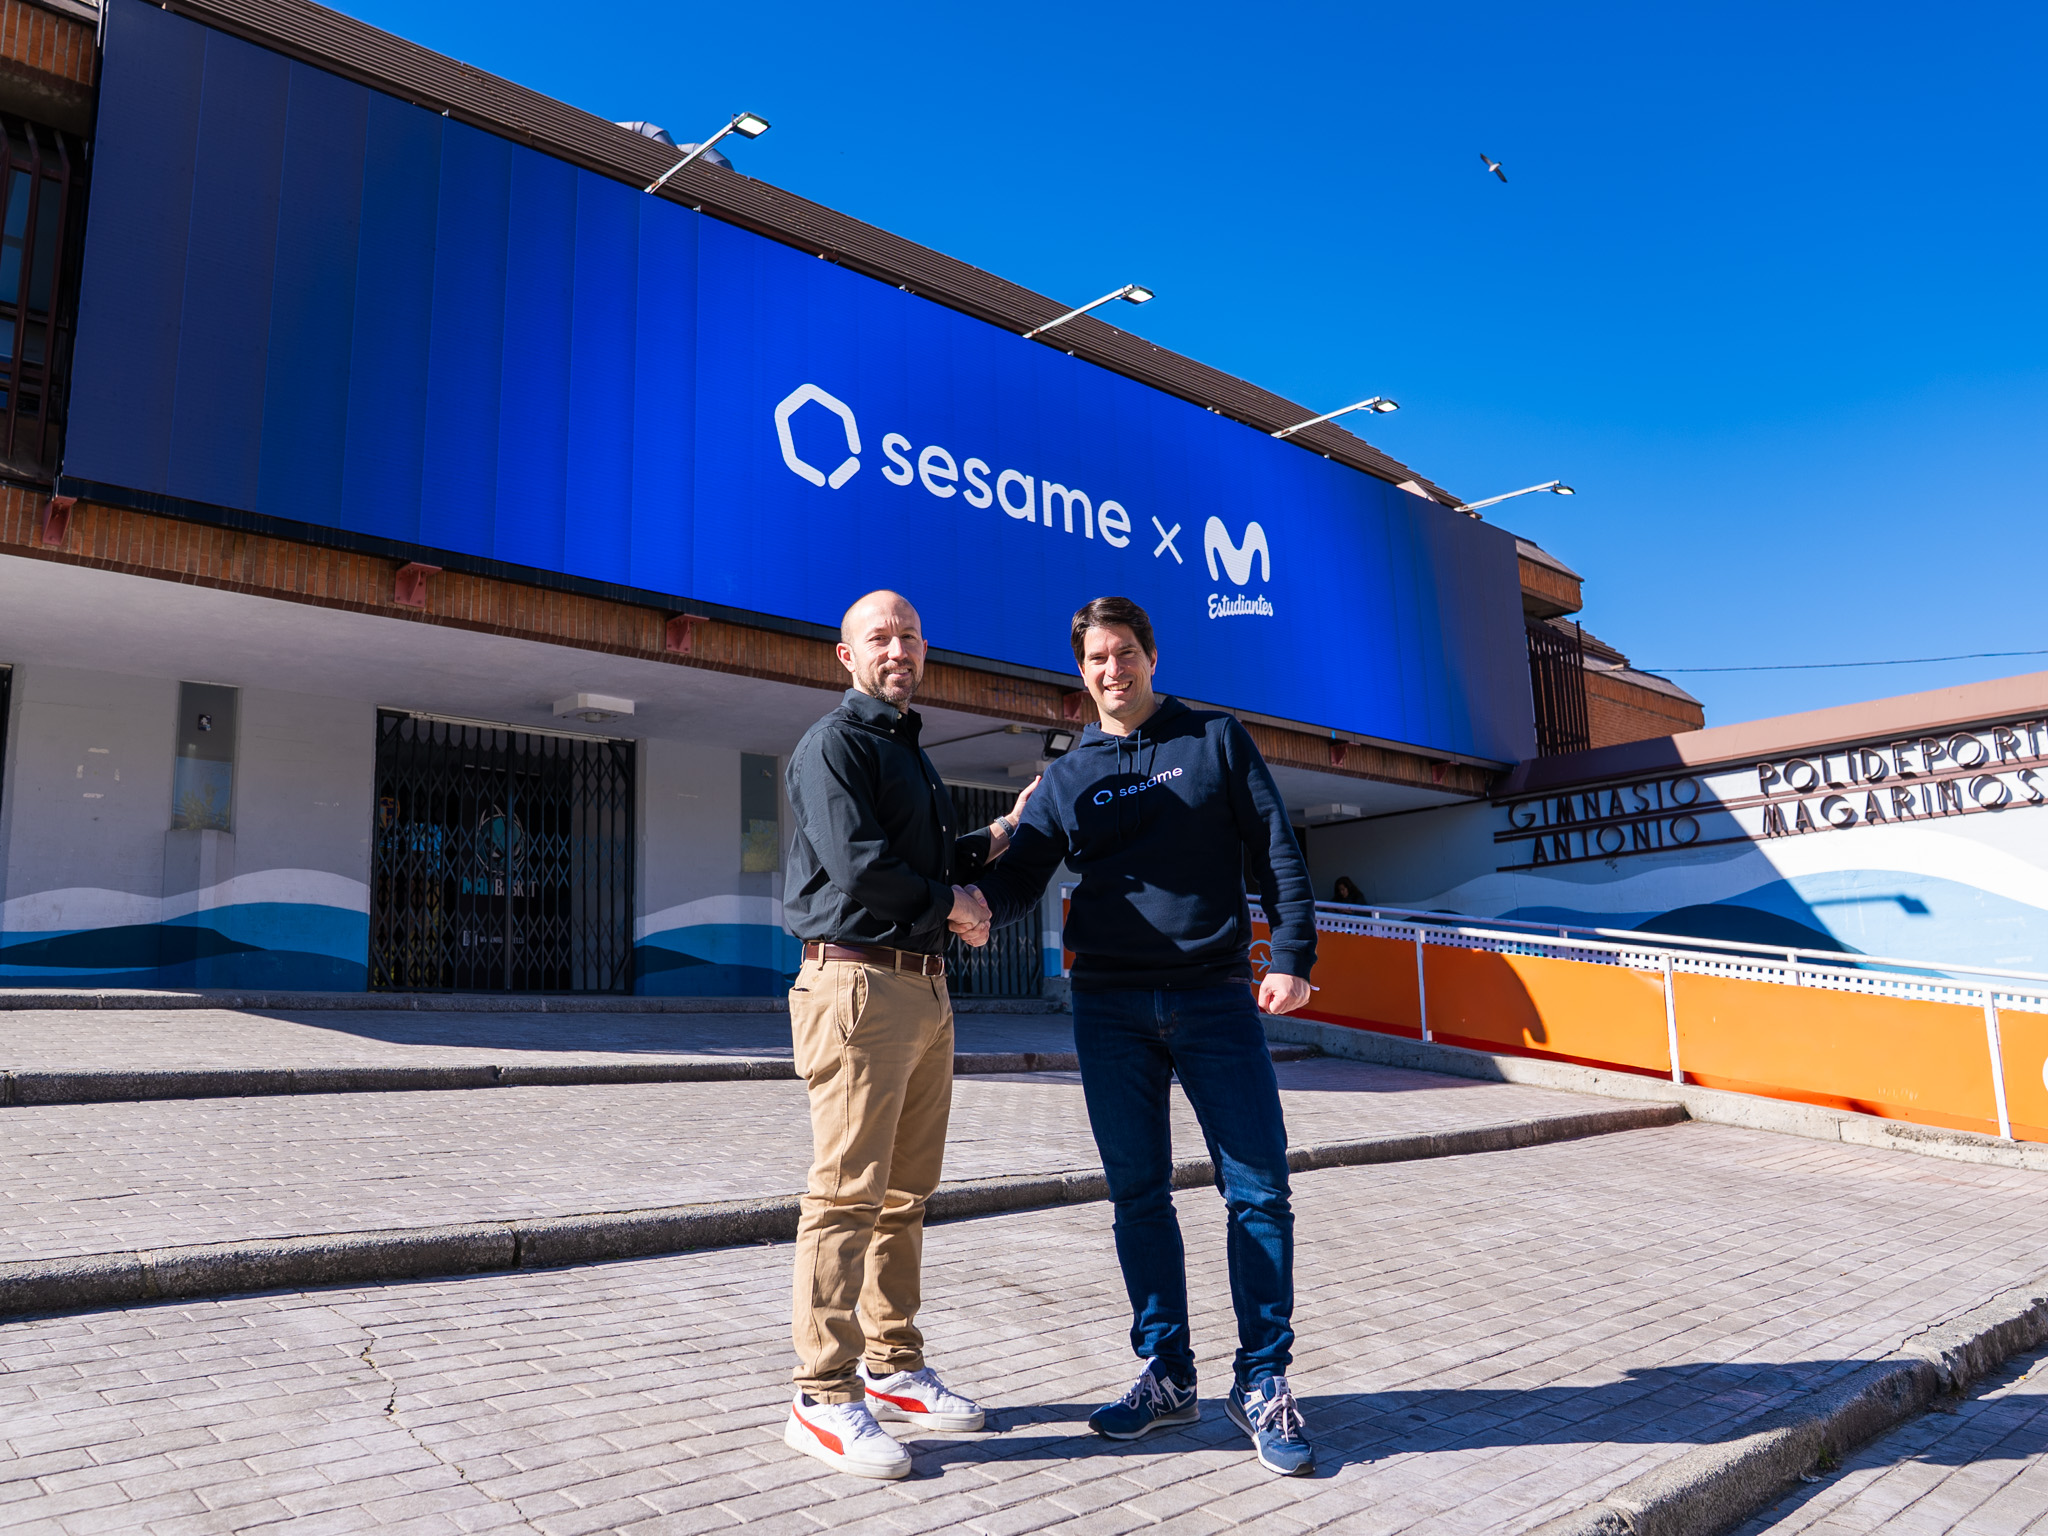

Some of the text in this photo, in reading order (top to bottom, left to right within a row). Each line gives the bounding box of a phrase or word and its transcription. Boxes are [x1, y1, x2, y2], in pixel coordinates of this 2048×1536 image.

[881, 432, 1132, 549] sesame
[1207, 593, 1274, 620] Estudiantes
[1119, 767, 1184, 797] sesame
[1508, 777, 1700, 830] GIMNASIO
[1533, 815, 1700, 864] ANTONIO
